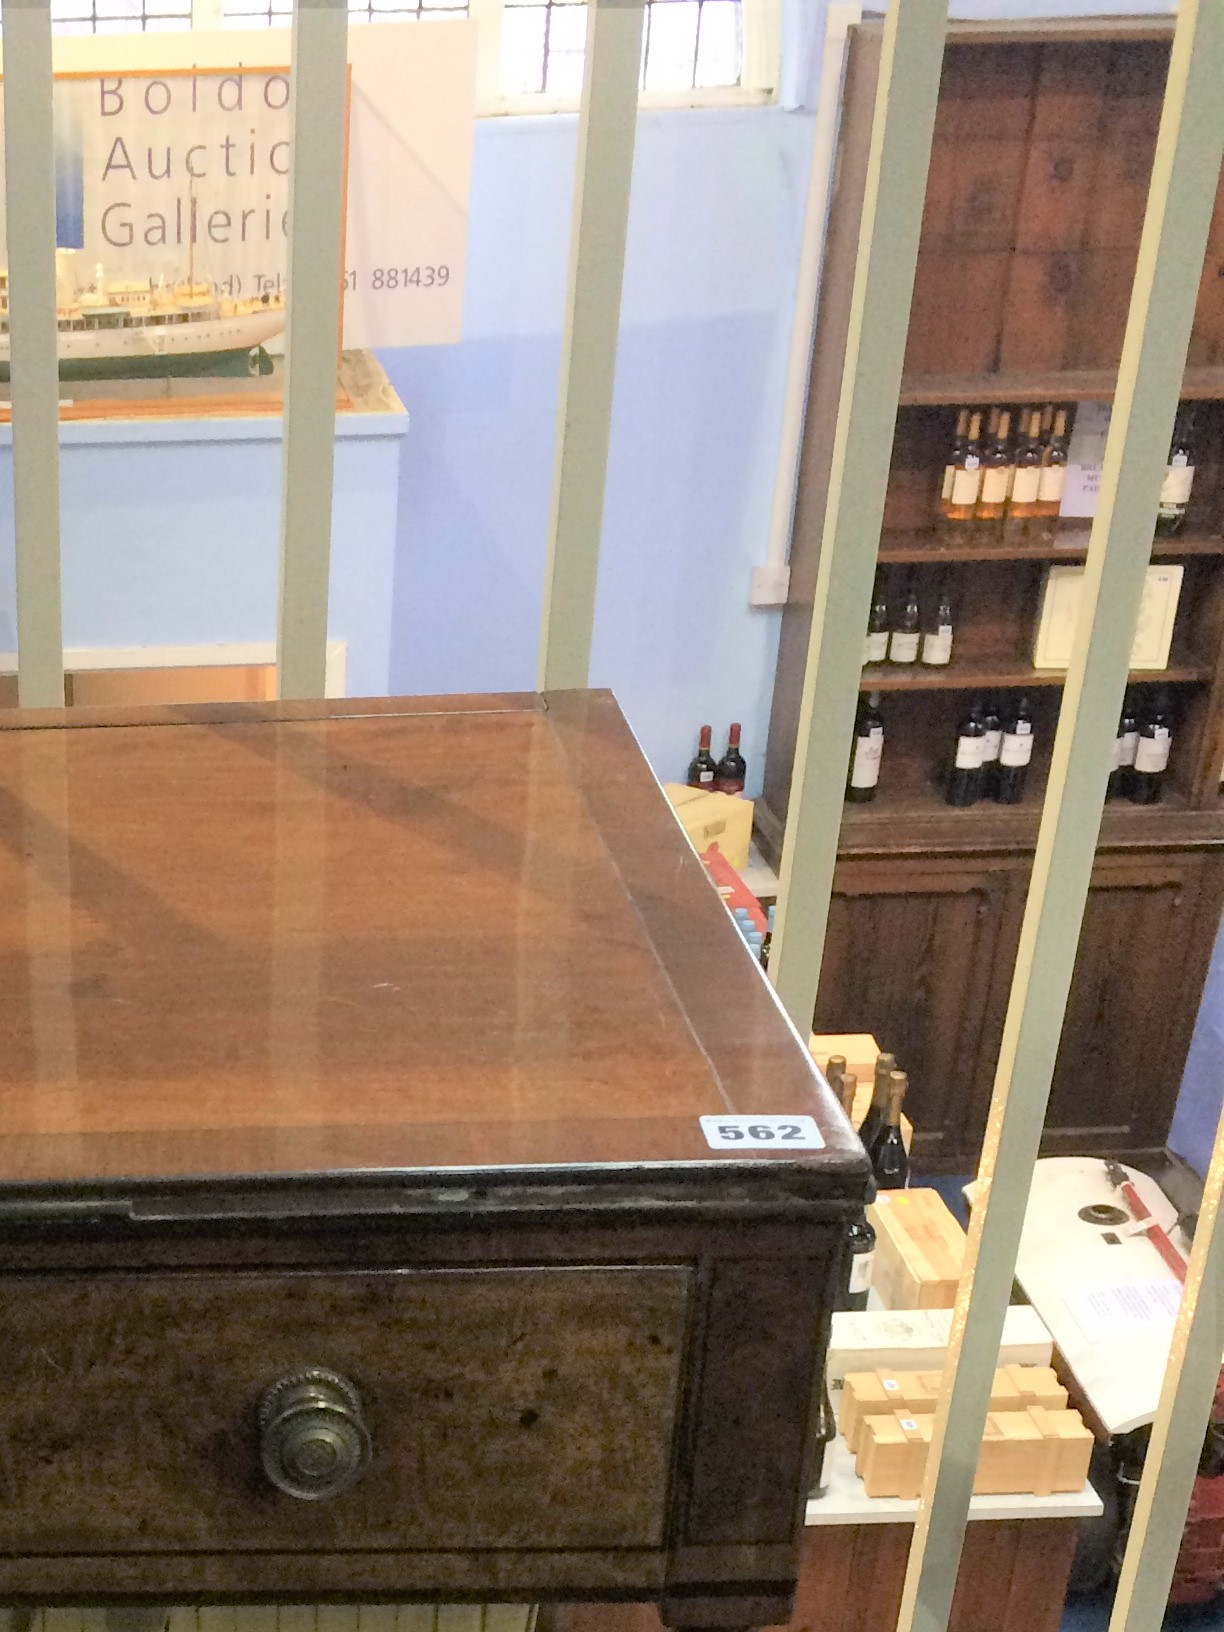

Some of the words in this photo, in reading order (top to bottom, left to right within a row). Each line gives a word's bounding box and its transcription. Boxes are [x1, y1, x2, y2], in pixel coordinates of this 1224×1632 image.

[101, 194, 288, 247] Galleri
[371, 265, 450, 290] 881439
[717, 1125, 806, 1140] 562
